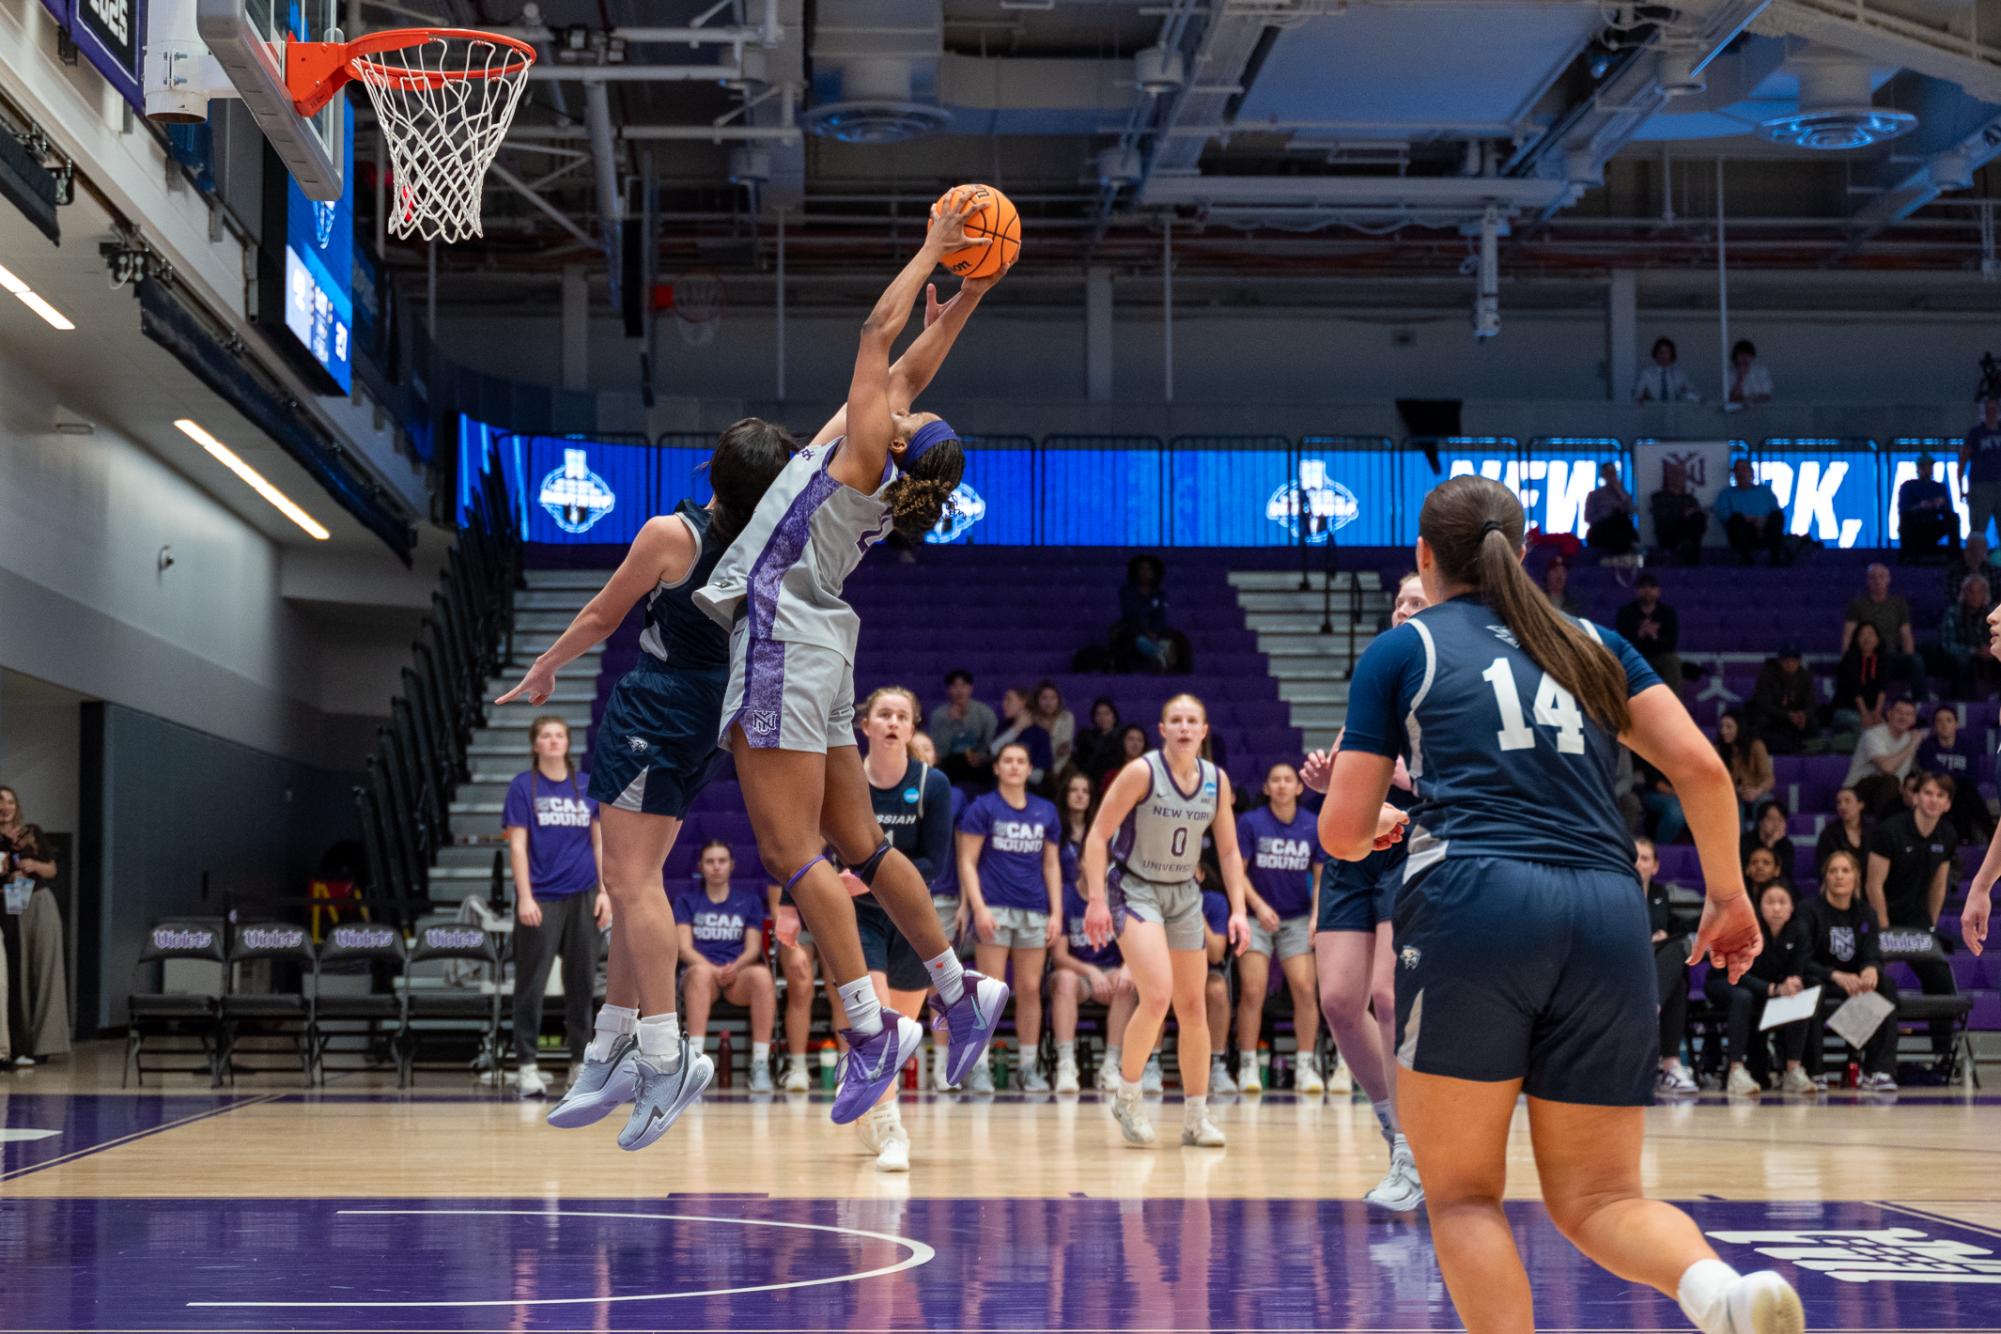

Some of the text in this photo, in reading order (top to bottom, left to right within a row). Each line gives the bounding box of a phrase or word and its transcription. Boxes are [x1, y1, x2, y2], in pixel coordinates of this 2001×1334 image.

[1450, 460, 1621, 541] EW
[1482, 657, 1585, 755] 14
[538, 812, 590, 827] BOUND
[1153, 806, 1182, 819] NEW
[992, 836, 1043, 853] BOUND
[1171, 827, 1188, 857] 0
[1256, 853, 1310, 871] BOUND
